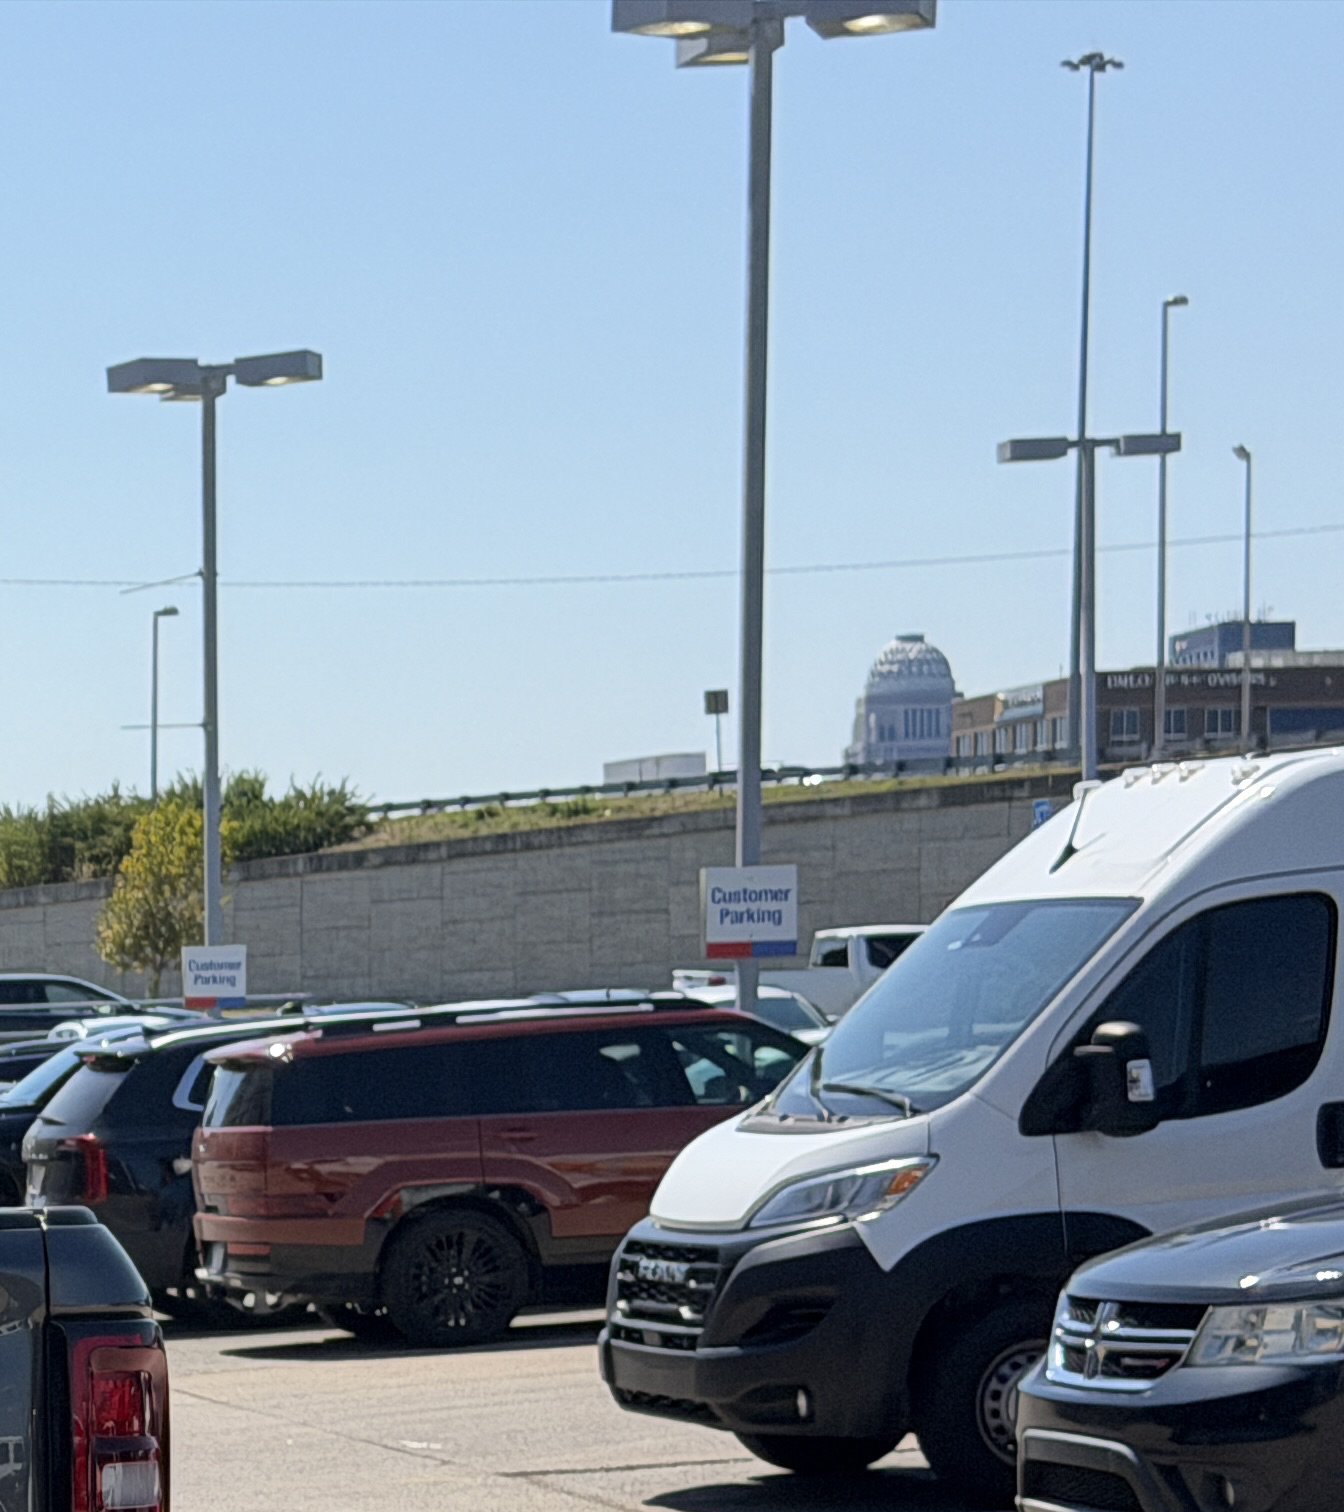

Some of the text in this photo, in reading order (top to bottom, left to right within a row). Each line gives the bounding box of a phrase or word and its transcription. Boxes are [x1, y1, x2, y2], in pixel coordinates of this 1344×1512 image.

[710, 886, 792, 905] Customer
[719, 907, 783, 927] Parking
[188, 958, 242, 973] Customer
[193, 973, 237, 987] Parking
